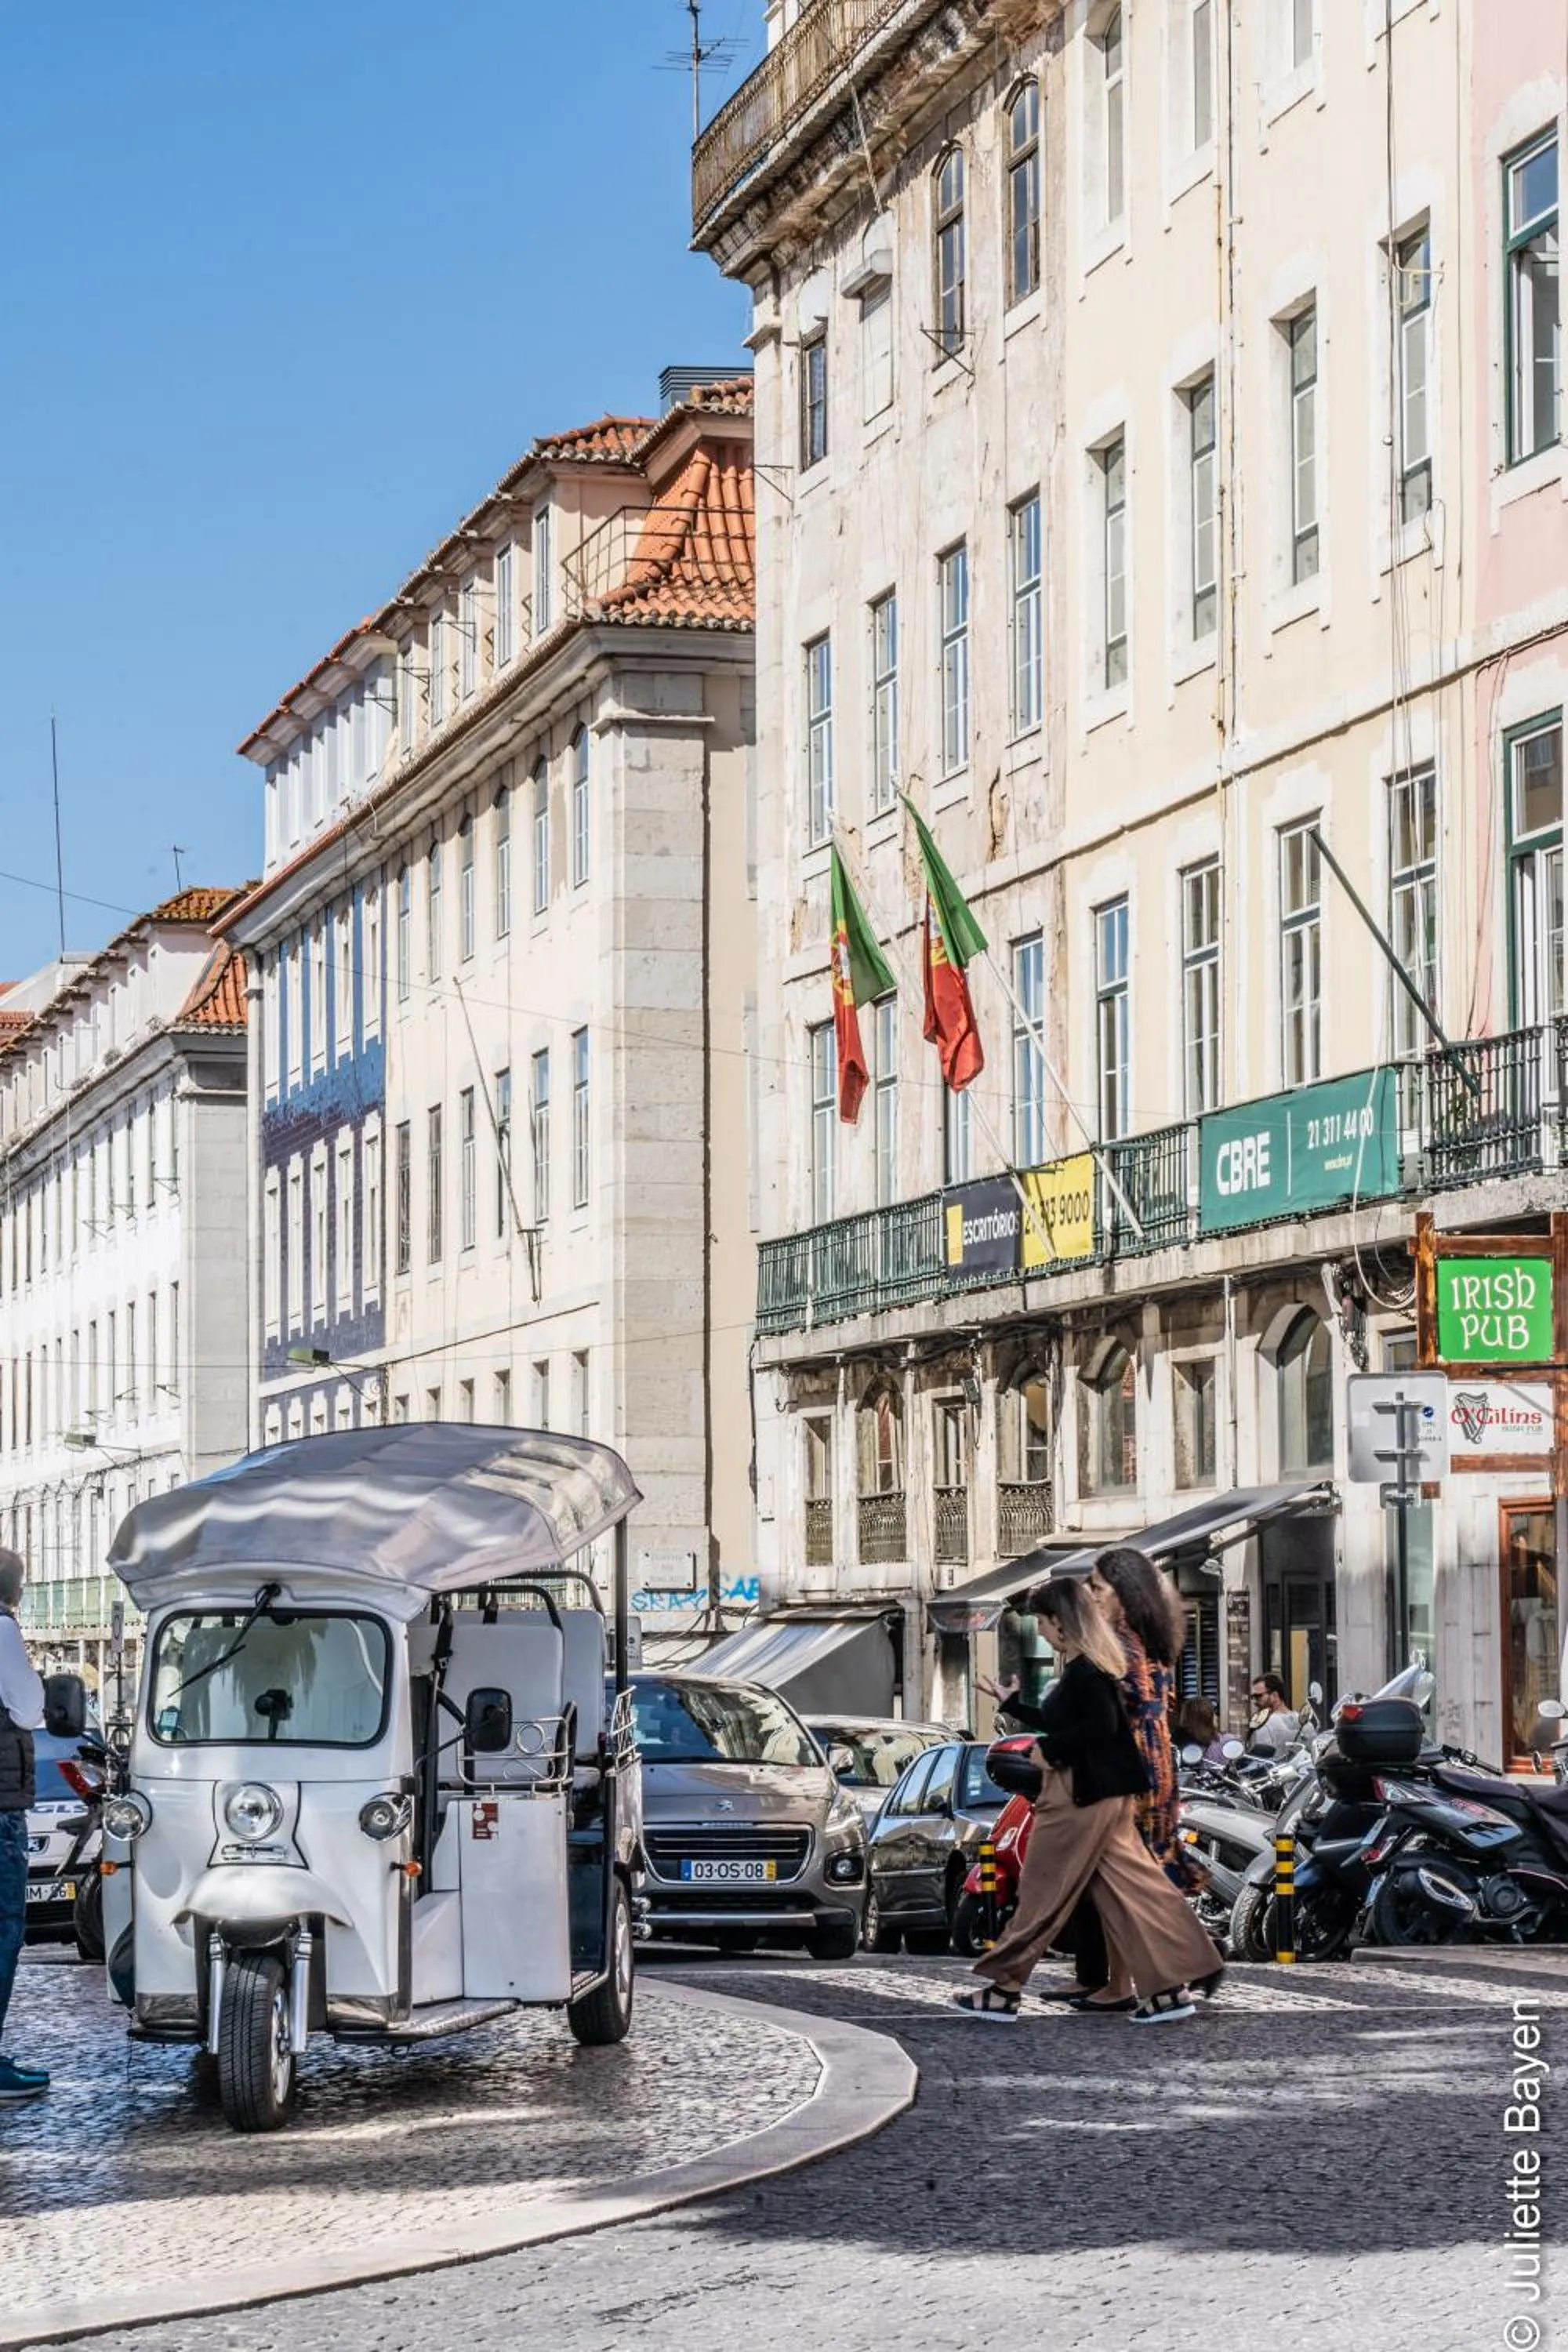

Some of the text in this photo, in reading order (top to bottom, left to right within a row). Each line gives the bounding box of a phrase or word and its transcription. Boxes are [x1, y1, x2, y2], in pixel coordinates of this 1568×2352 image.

[1307, 1119, 1319, 1150] 21
[1323, 1114, 1341, 1146] 311
[1343, 1109, 1357, 1141] 44
[1216, 1131, 1271, 1196] CBRE
[1059, 1189, 1091, 1226] 9000
[1460, 1313, 1530, 1351] PUB
